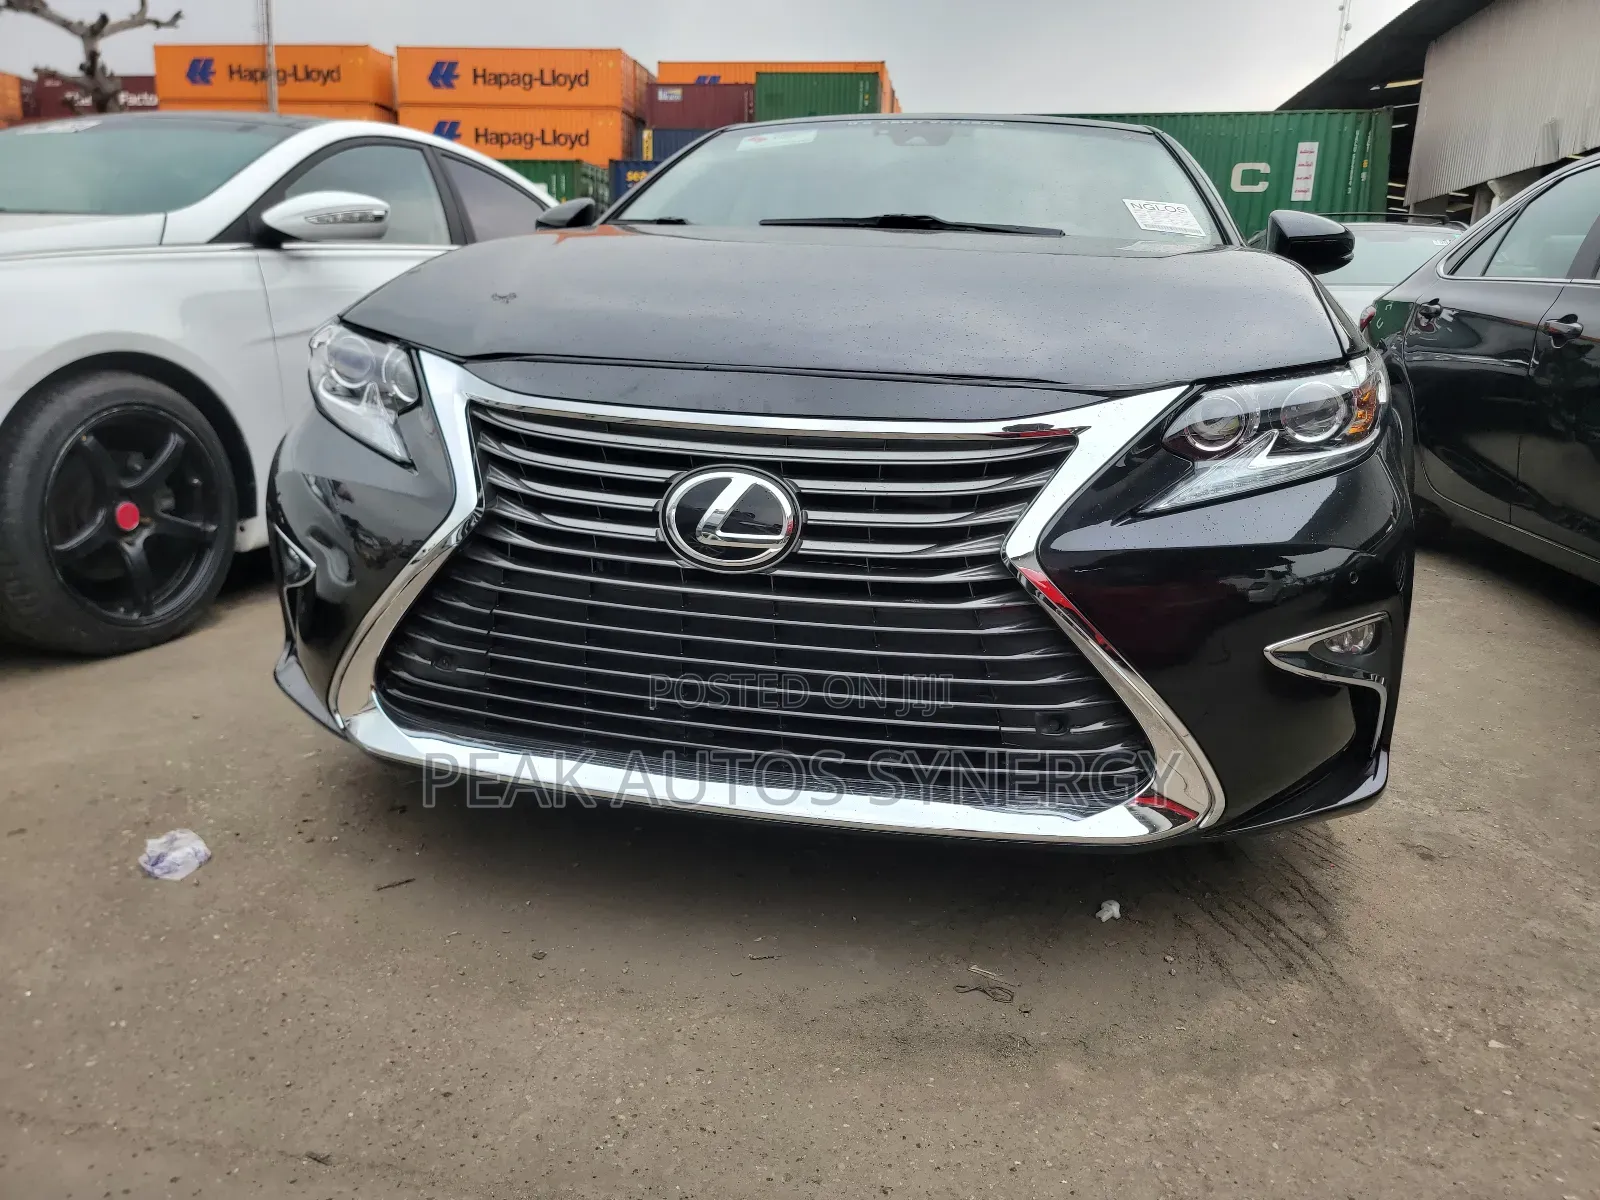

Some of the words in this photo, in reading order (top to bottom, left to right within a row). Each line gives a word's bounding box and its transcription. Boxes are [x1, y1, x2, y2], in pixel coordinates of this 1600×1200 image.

[472, 68, 589, 92] Hapag-Lloyd
[474, 128, 589, 150] Hapag-Lloyd
[1230, 162, 1271, 193] C
